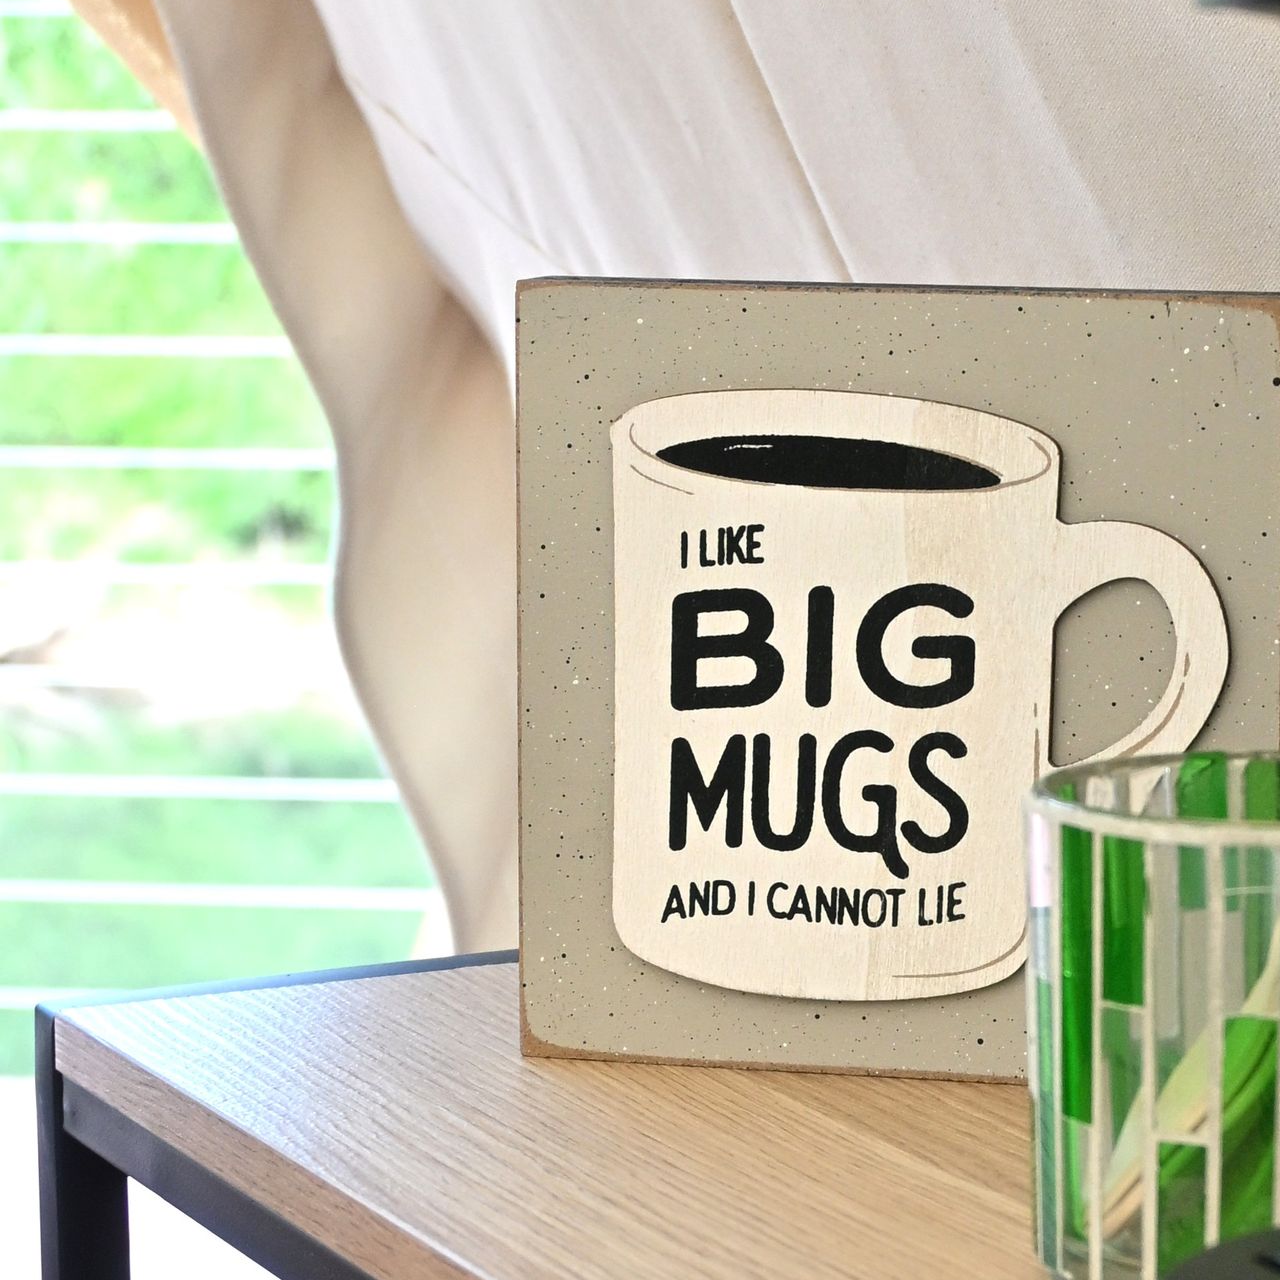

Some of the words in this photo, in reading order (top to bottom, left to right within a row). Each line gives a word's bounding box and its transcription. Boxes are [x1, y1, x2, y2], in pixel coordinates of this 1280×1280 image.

[679, 530, 689, 570] I
[699, 524, 765, 568] LIKE
[669, 583, 976, 712] BIG
[668, 729, 969, 880] MUGS
[661, 880, 736, 924] AND
[746, 880, 755, 917] I
[766, 883, 906, 928] CANNOT
[918, 882, 966, 926] LIE
